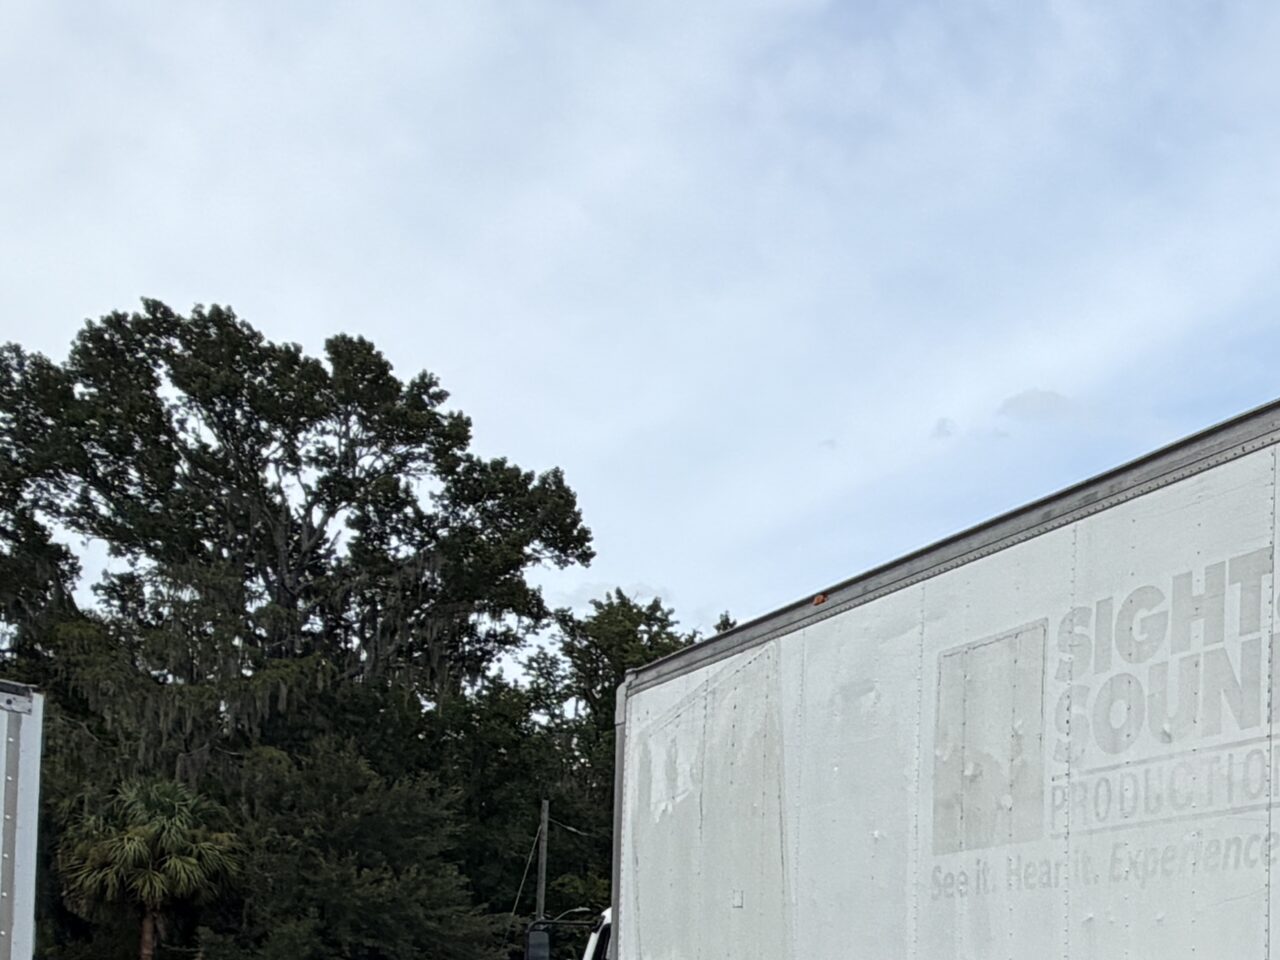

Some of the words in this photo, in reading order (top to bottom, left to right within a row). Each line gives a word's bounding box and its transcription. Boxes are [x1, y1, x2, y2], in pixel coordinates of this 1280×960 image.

[1054, 546, 1273, 682] SIGHT
[931, 864, 968, 899] See
[1007, 852, 1061, 891] Hear
[1074, 848, 1099, 885] it.
[1109, 830, 1280, 885] Experience
